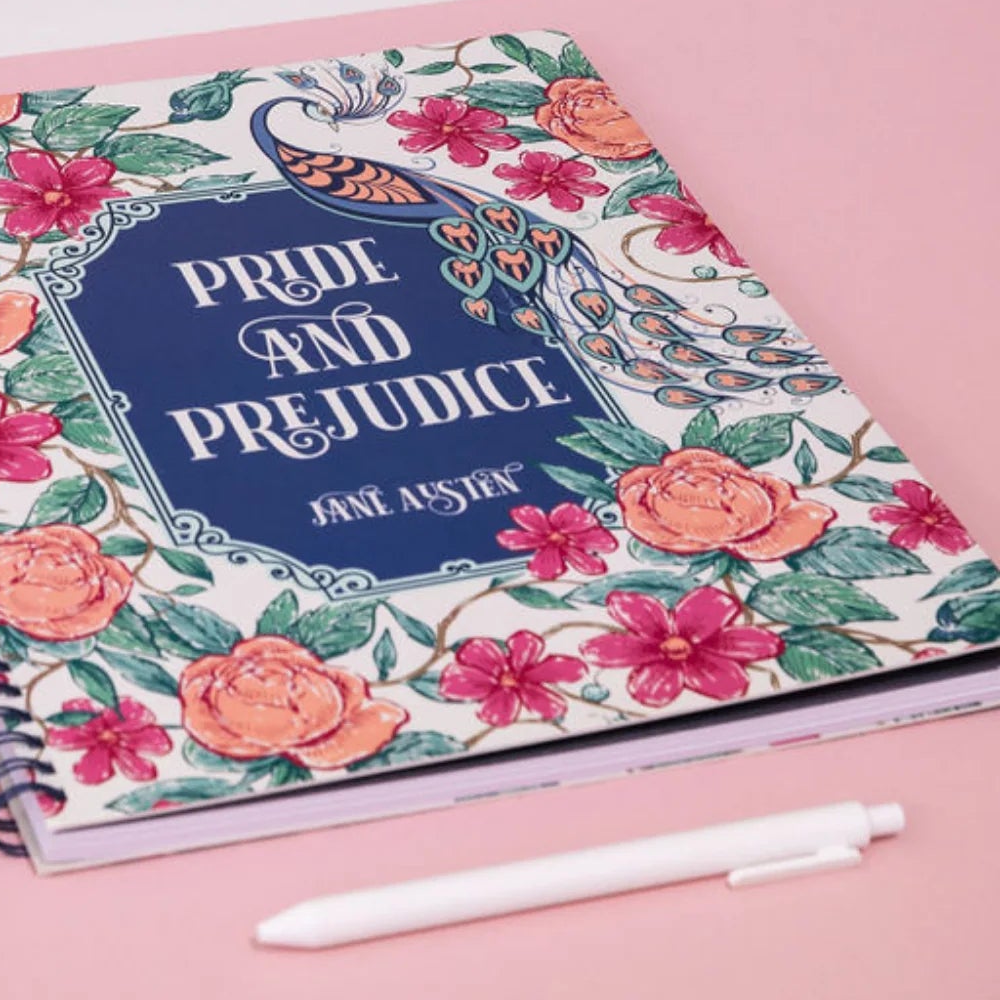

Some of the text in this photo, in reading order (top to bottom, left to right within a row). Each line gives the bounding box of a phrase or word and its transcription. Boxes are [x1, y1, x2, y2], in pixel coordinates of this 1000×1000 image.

[171, 237, 399, 308] PRIDE
[238, 301, 411, 379] AND
[165, 356, 571, 460] PREJUDICE
[308, 462, 524, 527] JANE AUSTEN
